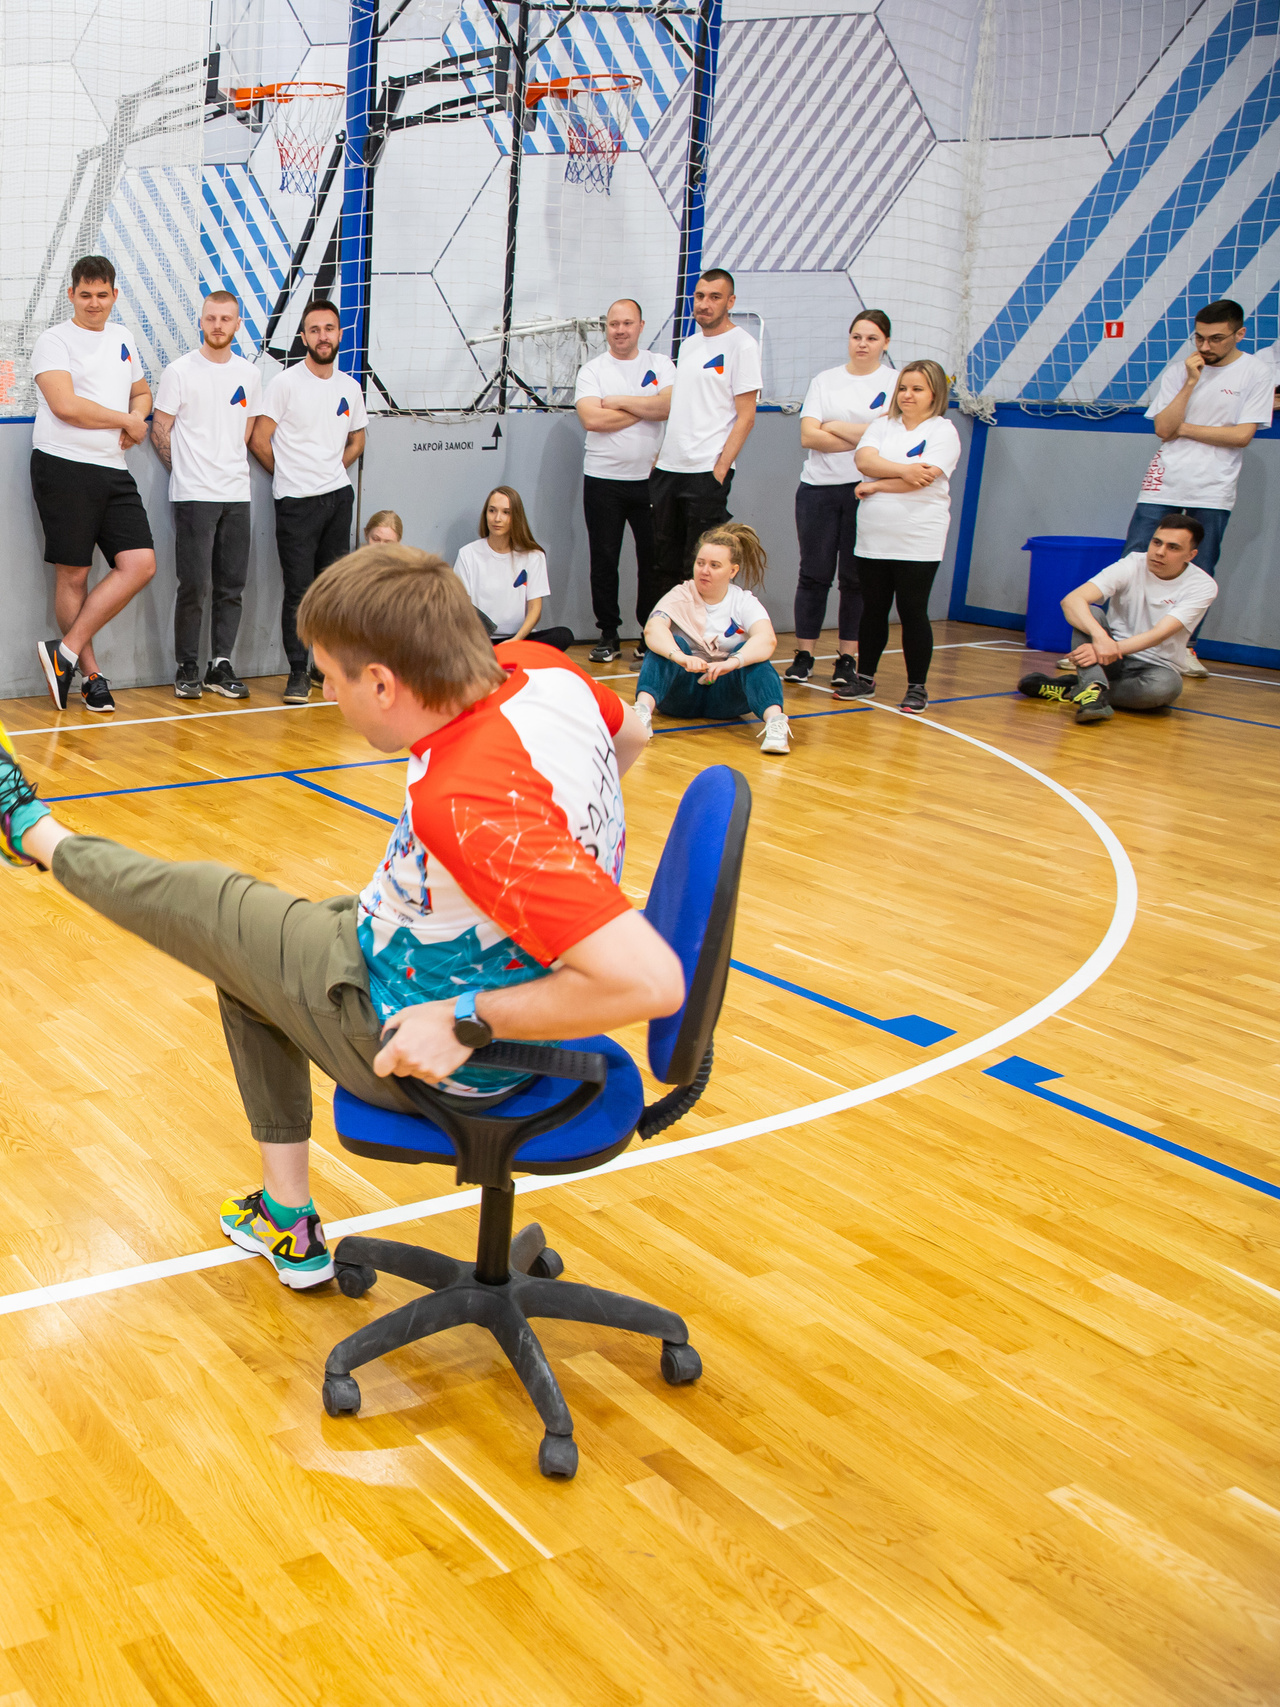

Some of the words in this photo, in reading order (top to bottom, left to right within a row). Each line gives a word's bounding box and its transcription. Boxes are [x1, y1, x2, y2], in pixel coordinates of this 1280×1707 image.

[412, 440, 443, 452] ЗАКРОЙ
[444, 441, 474, 451] ЗАМОК!
[1150, 467, 1166, 491] НАС
